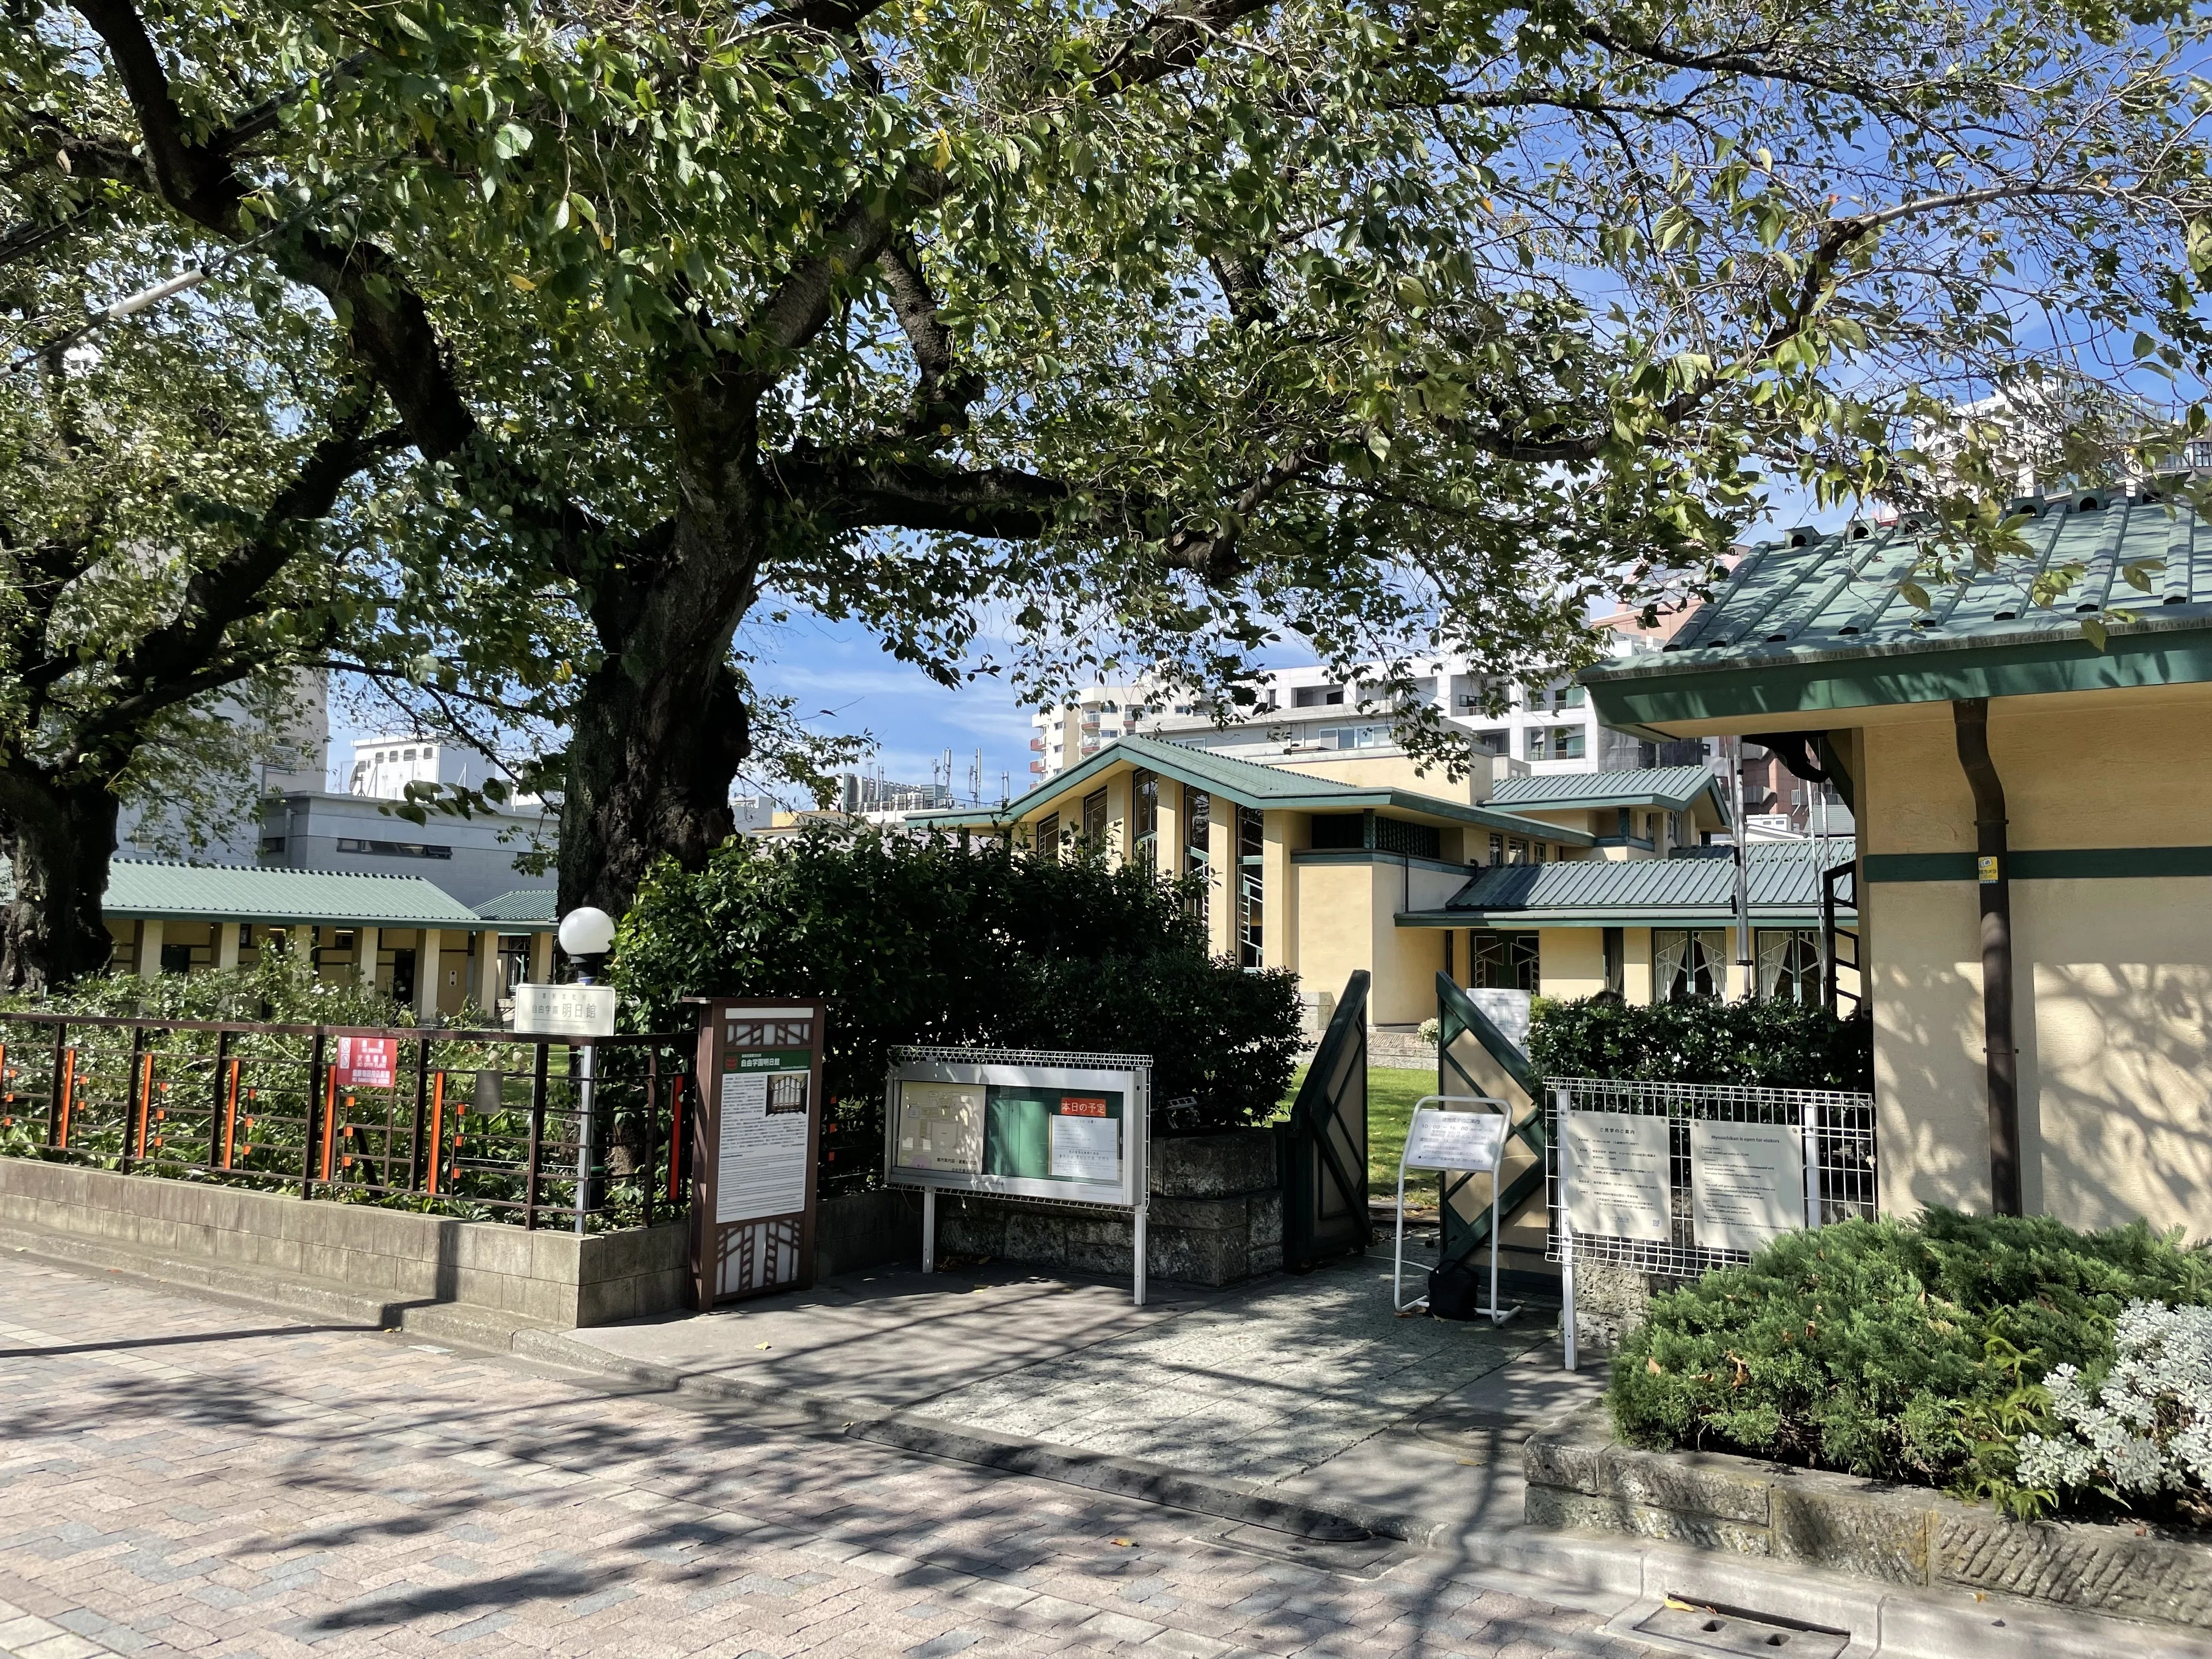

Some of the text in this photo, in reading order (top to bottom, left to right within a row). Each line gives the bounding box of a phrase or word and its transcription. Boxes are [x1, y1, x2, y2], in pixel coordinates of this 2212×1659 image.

[1062, 1101, 1105, 1114] 本日の予定
